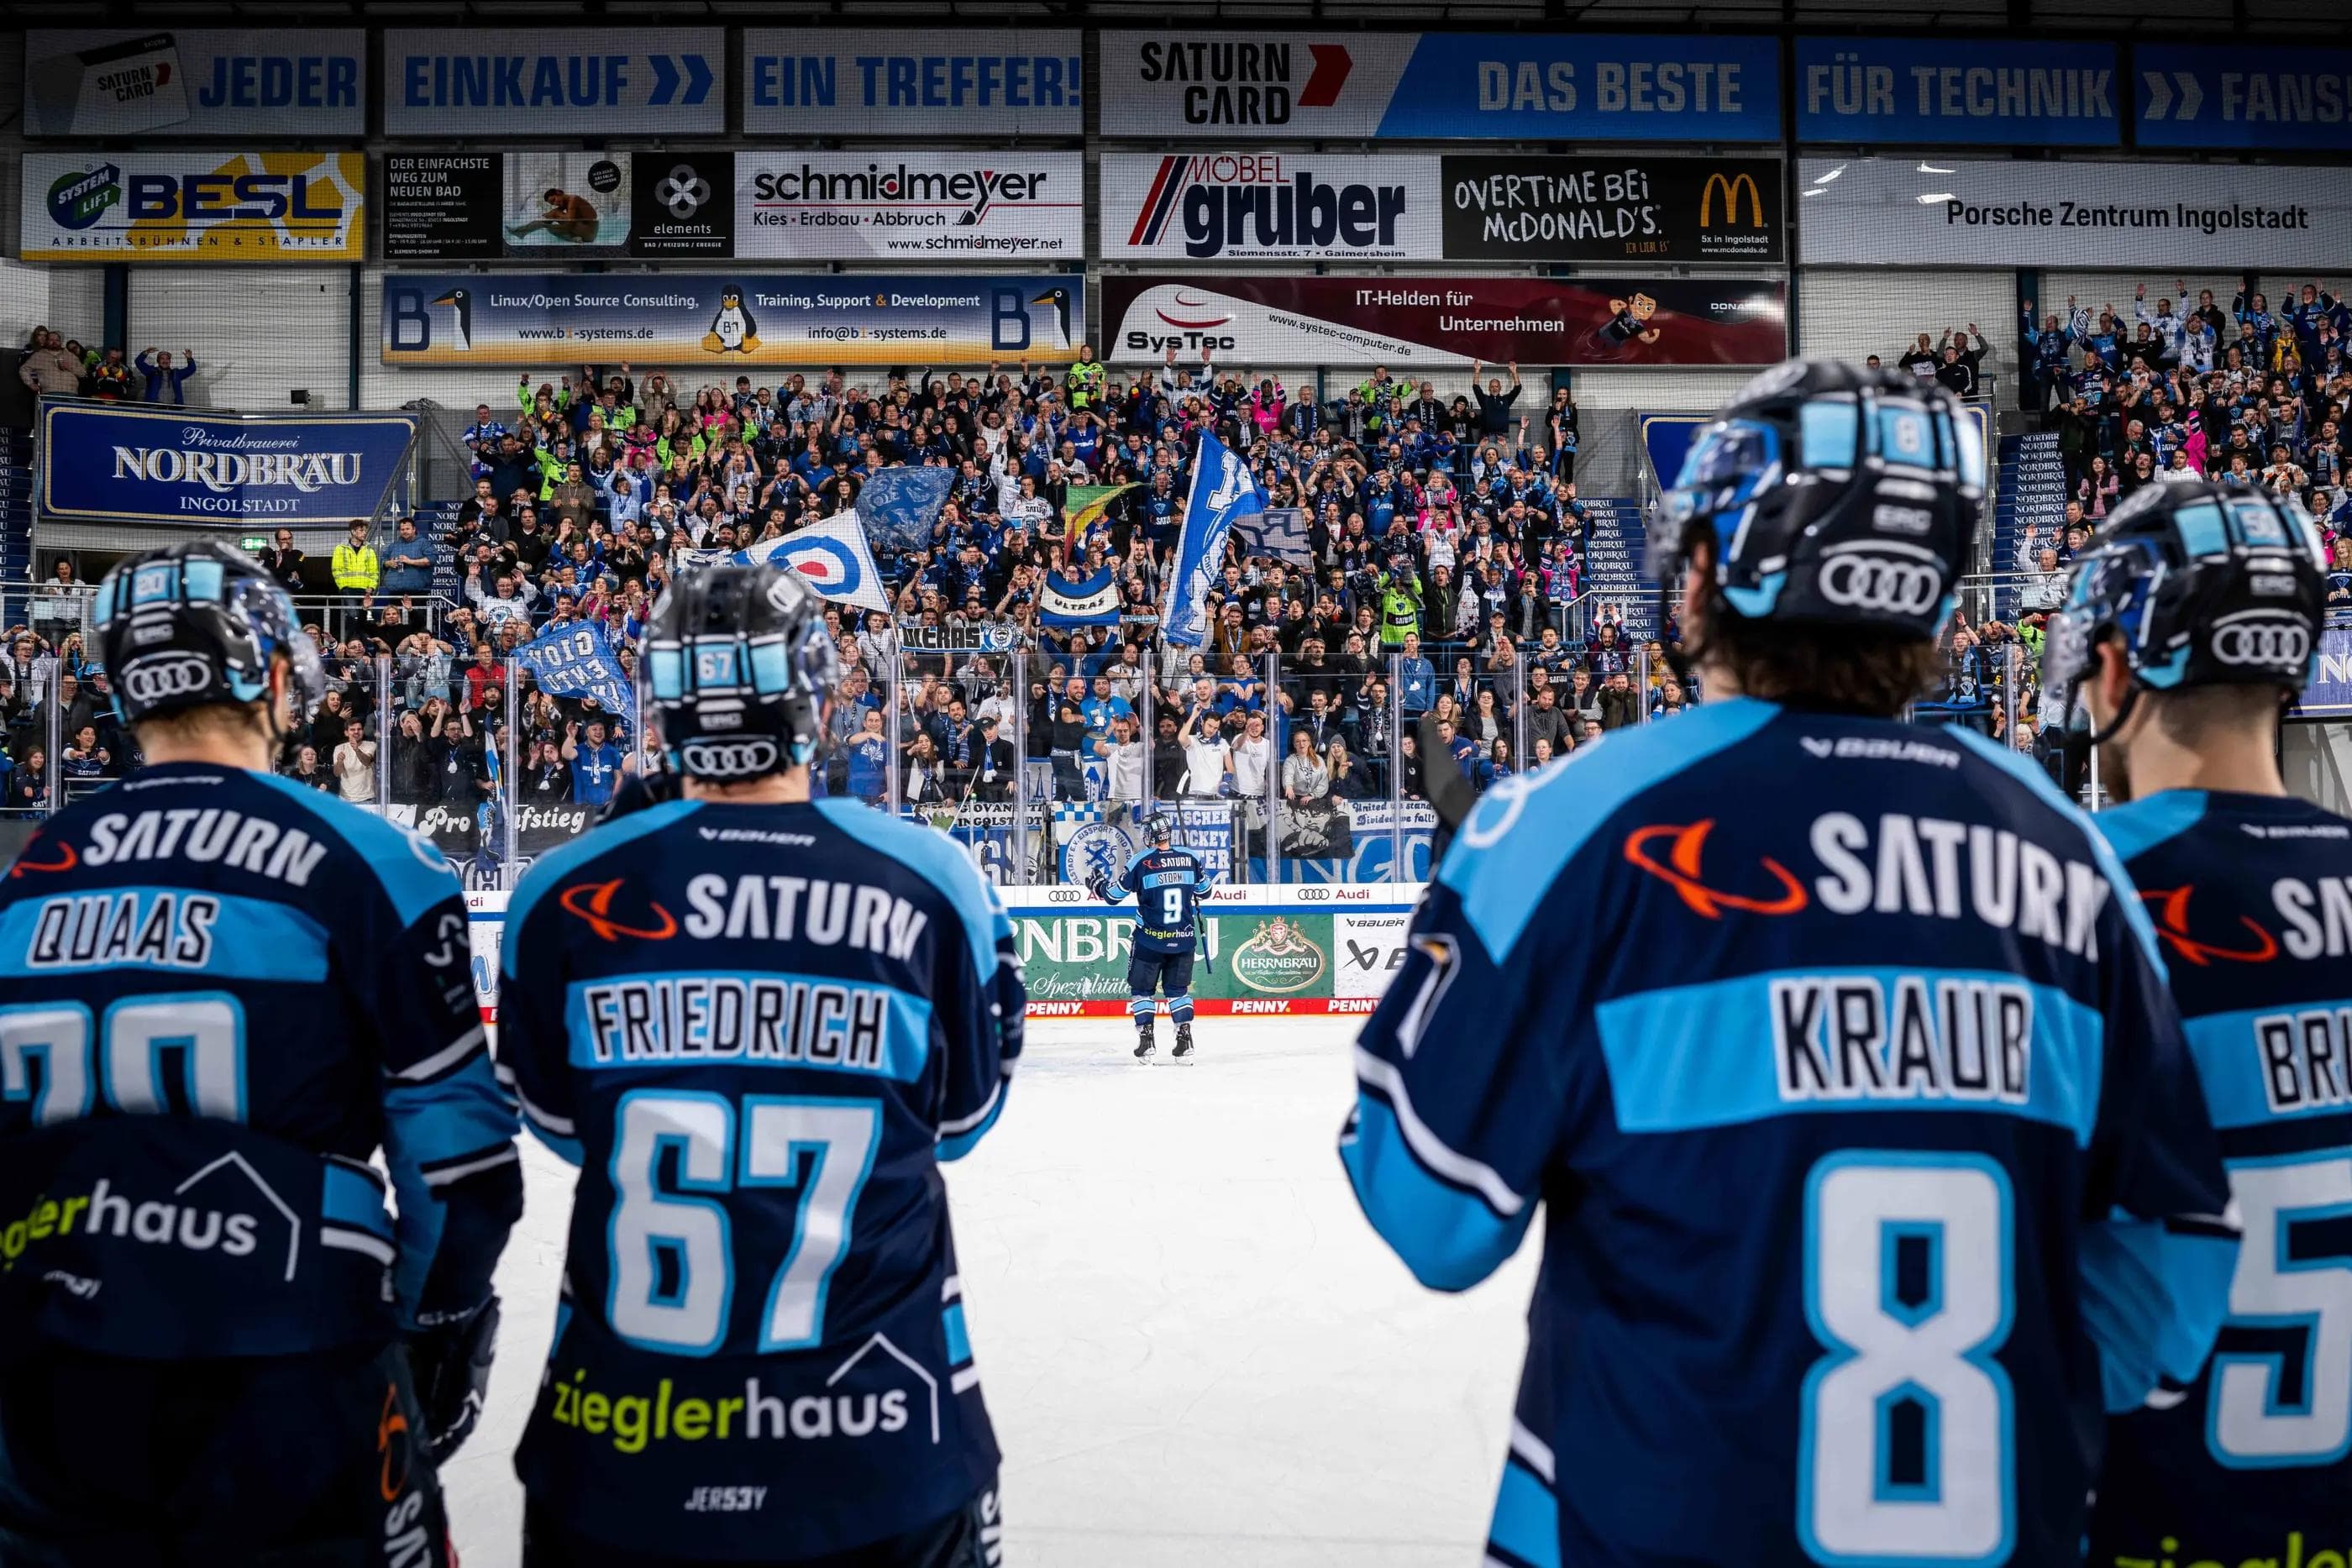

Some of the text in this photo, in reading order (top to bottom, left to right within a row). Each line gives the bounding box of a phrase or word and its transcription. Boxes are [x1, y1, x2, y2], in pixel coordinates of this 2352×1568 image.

[1141, 42, 1289, 83] SATURN
[97, 66, 151, 91] SATURN
[199, 56, 356, 108] JEDER
[405, 55, 629, 107] EINKAUF
[754, 56, 1080, 107] EIN TREFFER!
[1478, 61, 1742, 113] DAS BESTE
[1808, 54, 2113, 119] FÜR TECHNIK
[116, 81, 154, 102] CARD
[1184, 85, 1289, 125] CARD
[391, 158, 490, 169] DER EINFACHSTE
[1189, 155, 1289, 183] MÖBEL
[57, 168, 110, 206] SYSTEM
[390, 172, 447, 183] WEG ZUM
[754, 164, 1047, 208] schmidmeyer
[82, 190, 112, 212] LIFT
[129, 175, 342, 219] BESL
[390, 186, 461, 197] NEUEN BAD
[753, 211, 946, 227] Kies Erdbau Abbruch
[1183, 172, 1406, 257] gruber
[1947, 201, 2309, 235] Porsche Zentrum Ingolstadt
[654, 223, 711, 234] elements
[52, 235, 343, 247] ARBEITSBÜHNEN & STAPLER
[888, 235, 1063, 254] www.schmidmeyer.net
[1701, 235, 1769, 245] 5x in Ingolstadt
[491, 294, 700, 311] Linux/Open Source Consulting,
[756, 294, 979, 311] Training, Support & Development
[1356, 290, 1473, 307] IT-Helden für
[519, 326, 654, 343] www.b1-systems.de
[808, 326, 947, 343] info@b1-systems.de
[1439, 316, 1564, 333] Unternehmen
[1126, 331, 1236, 353] SysTec
[1268, 312, 1412, 358] www.systec-computer.de
[181, 426, 301, 450] Privatbrauerei
[2021, 442, 2058, 450] NORDBR
[2023, 433, 2059, 442] NORDBR
[112, 446, 362, 492] NORDBRÄU
[181, 496, 300, 513] INGOLSTADT
[2016, 493, 2066, 503] NORDBRÄU
[2014, 514, 2066, 524] NORDBRÄU
[1588, 551, 1630, 560] ORDBRÄU
[1054, 595, 1105, 610] ULTRAS
[696, 651, 732, 680] 67
[1352, 802, 1387, 813] United
[418, 806, 470, 837] Pro
[958, 817, 1042, 827] INGOLSTDT
[1415, 813, 1435, 823] fall!
[83, 809, 328, 886] SATURN
[1161, 857, 1192, 868] SATURN
[1158, 873, 1183, 884] STORM
[1809, 811, 2110, 962] SATURN
[1212, 890, 1247, 900] Audi
[1336, 889, 1370, 899] Audi
[1163, 888, 1182, 924] 9
[685, 874, 928, 962] SATURN
[1357, 919, 1405, 927] BAUER
[28, 894, 219, 968] QUAAS
[1145, 929, 1194, 940] zieglerhaus
[1242, 957, 1317, 969] HERRNBRÄU
[585, 978, 890, 1070] FRIEDRICH
[606, 1088, 884, 1358] 67
[1796, 1147, 2017, 1568] 8
[553, 1369, 908, 1454] zieglerhaus
